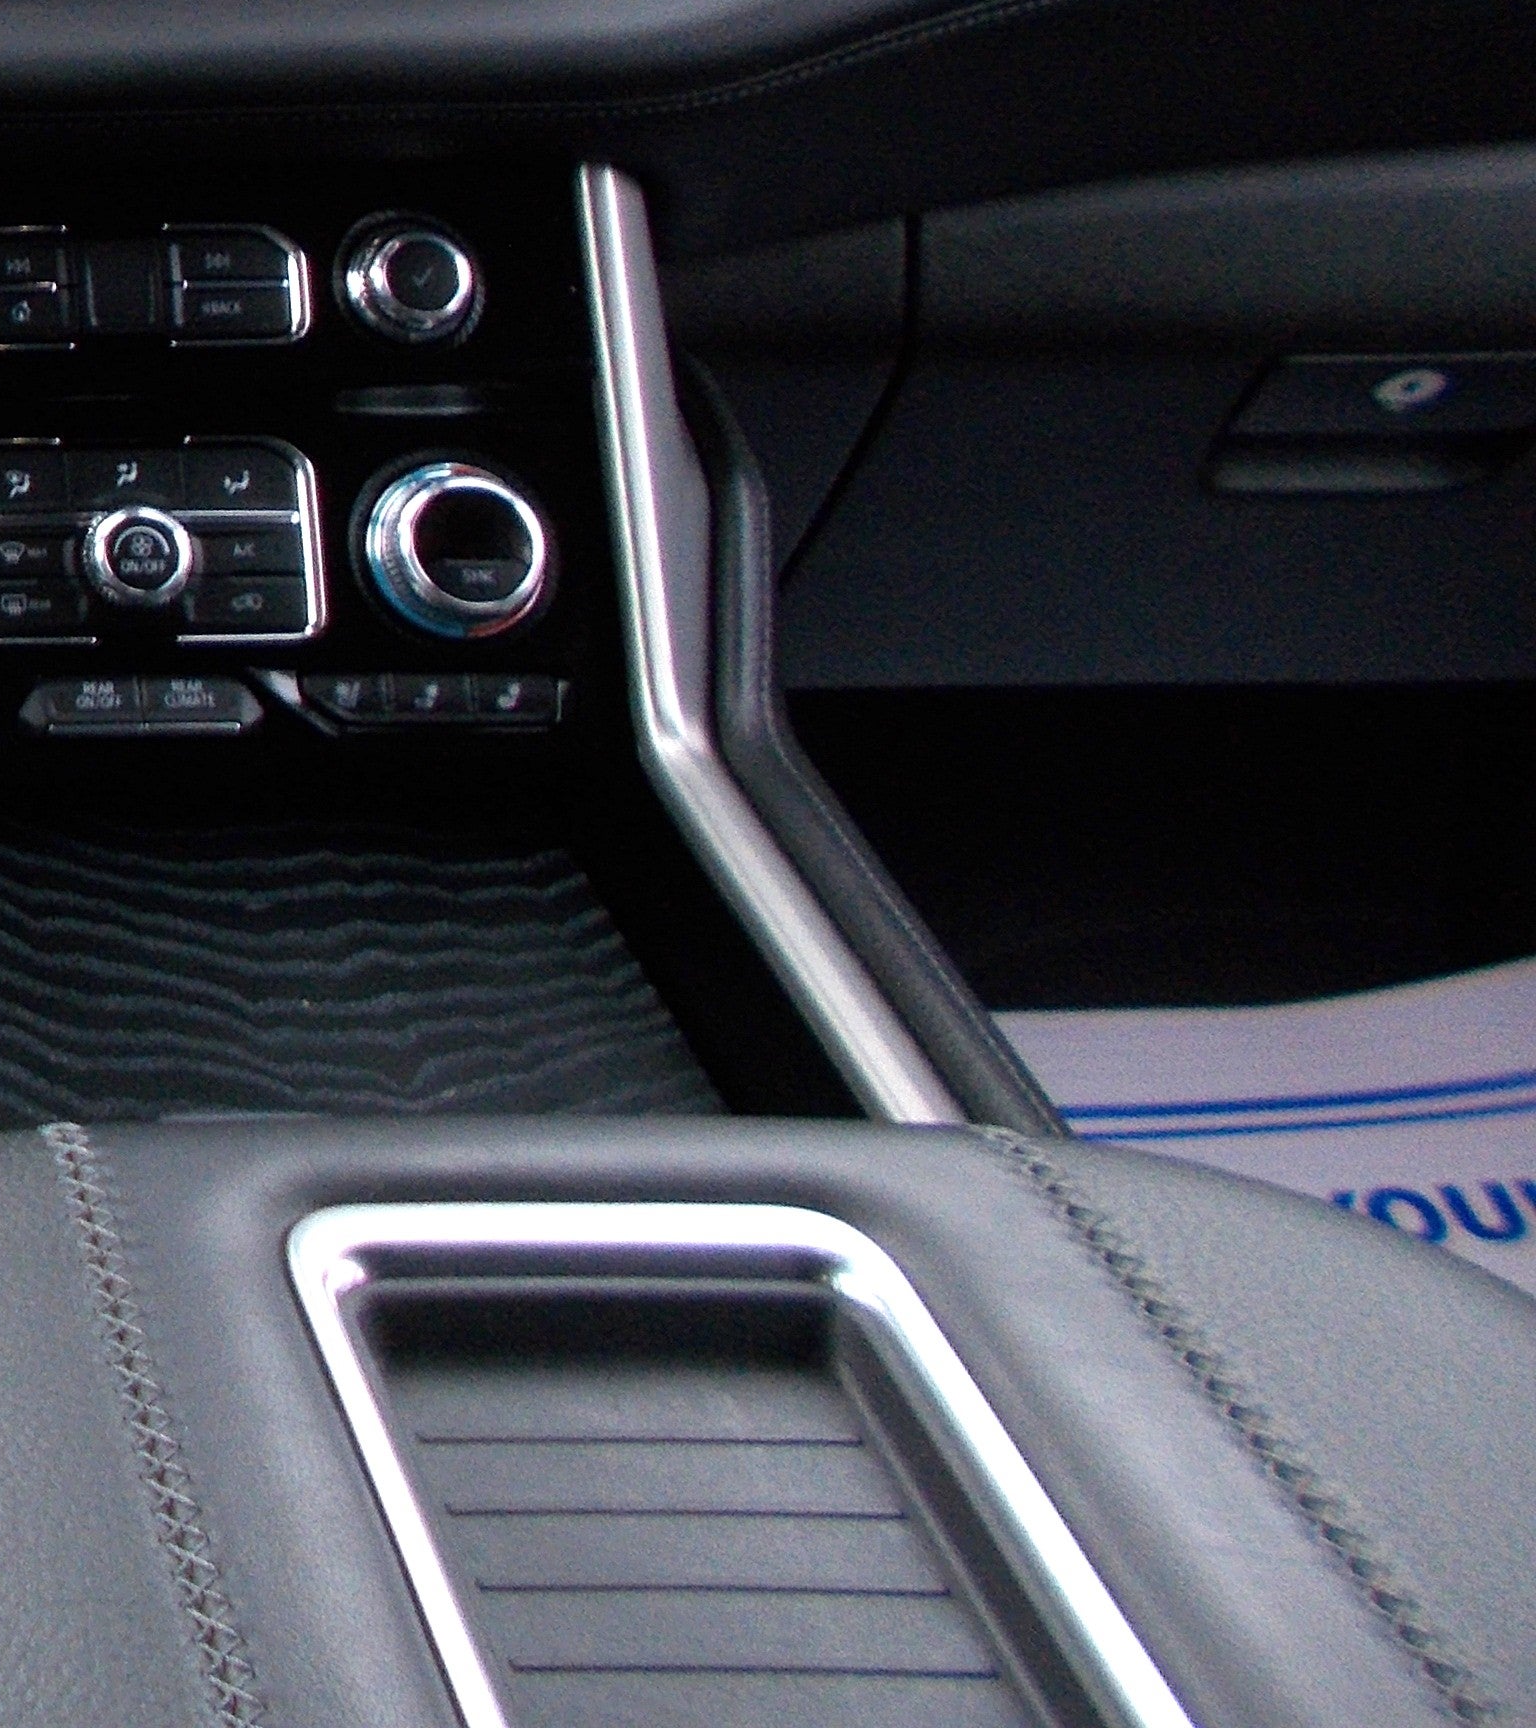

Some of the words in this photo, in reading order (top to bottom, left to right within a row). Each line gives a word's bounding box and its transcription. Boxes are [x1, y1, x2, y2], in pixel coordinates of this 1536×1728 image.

[232, 542, 256, 559] A/C
[119, 559, 167, 575] ON/OFF
[82, 679, 115, 694] REAR
[164, 691, 216, 708] CLIMATE
